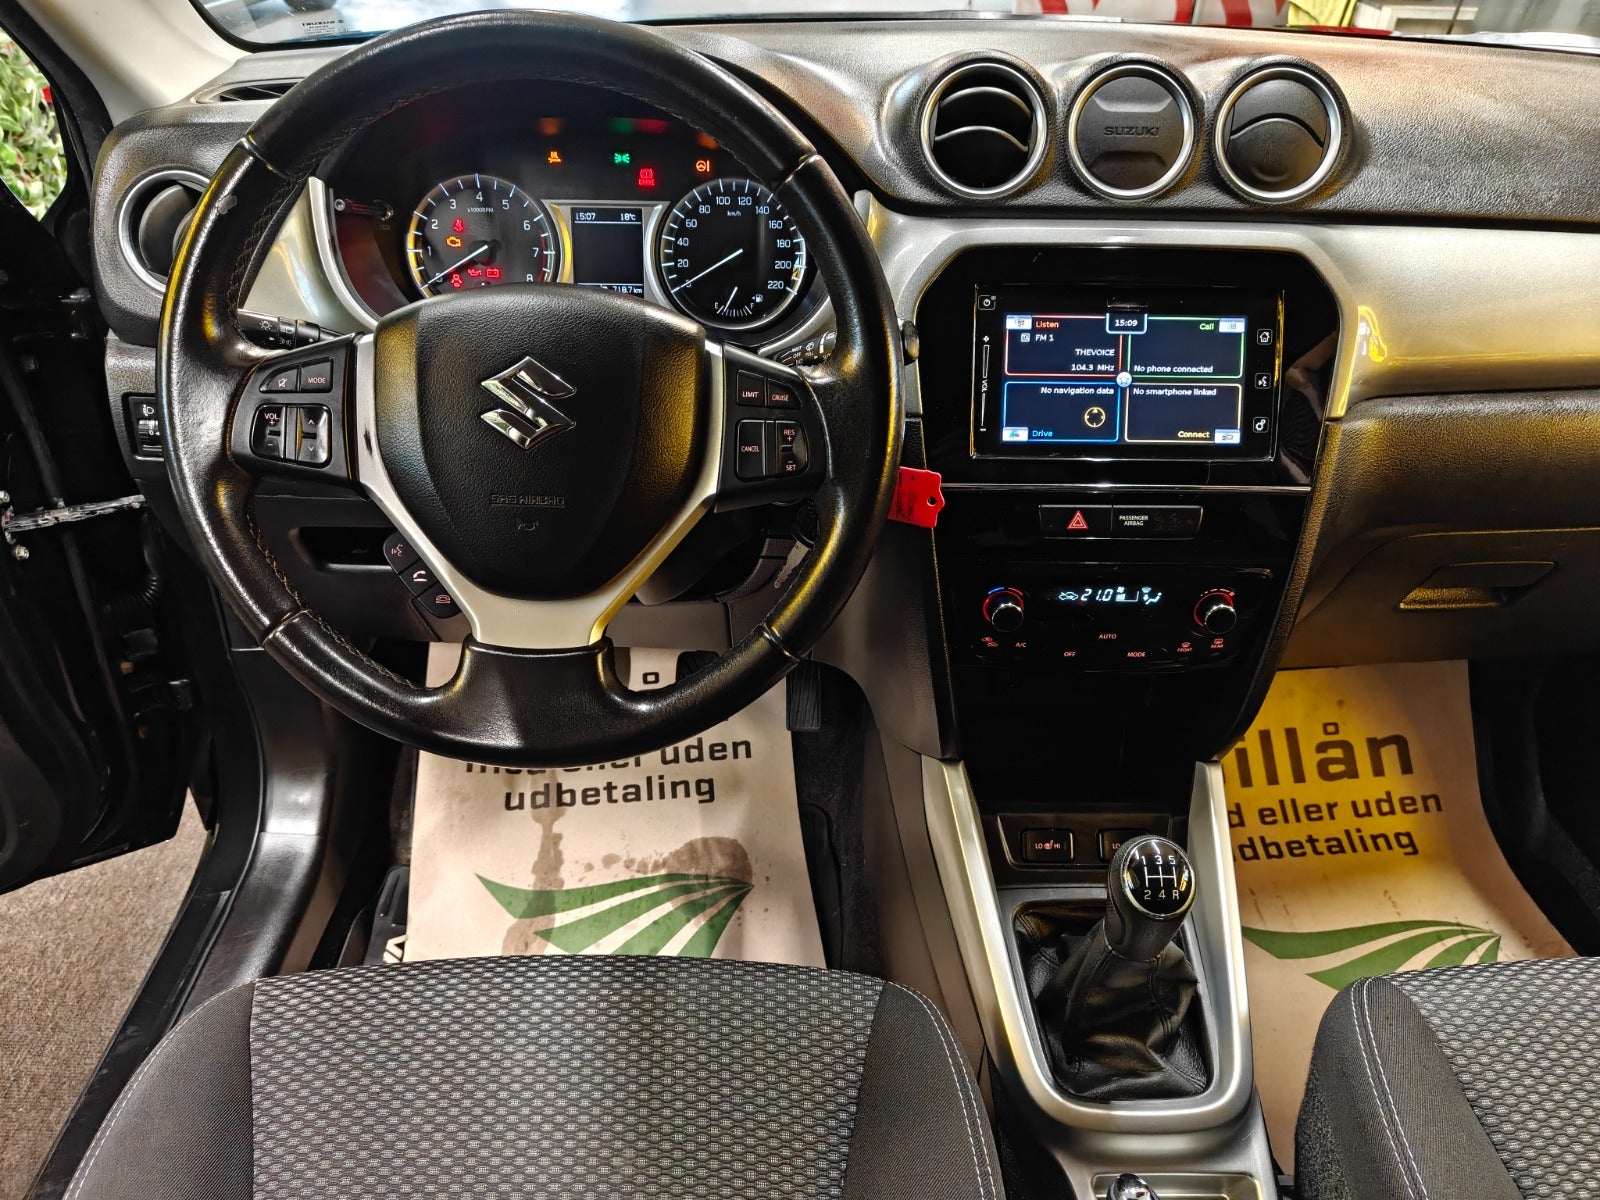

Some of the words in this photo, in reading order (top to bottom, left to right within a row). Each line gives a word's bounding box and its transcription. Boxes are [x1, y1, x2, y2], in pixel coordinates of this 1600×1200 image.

[1104, 126, 1160, 137] SUZUKI
[476, 191, 484, 202] 4
[716, 196, 731, 206] 100
[738, 196, 753, 206] 120
[450, 199, 457, 210] 3
[502, 200, 511, 210] 5
[698, 204, 711, 214] 80
[755, 205, 770, 215] 140
[575, 212, 596, 221] 15:07
[431, 219, 439, 230] 2
[523, 220, 531, 231] 6
[685, 219, 698, 228] 60
[768, 220, 783, 230] 160
[677, 238, 689, 247] 40
[776, 239, 791, 249] 180
[427, 246, 432, 256] 1
[533, 248, 539, 258] 7
[677, 259, 689, 268] 20
[774, 260, 792, 270] 200
[767, 280, 784, 290] 220
[1035, 320, 1060, 329] Listen
[1114, 319, 1138, 327] 15:09
[1199, 322, 1215, 331] Call
[1035, 333, 1047, 342] FM
[1075, 347, 1115, 356] THEVOICE
[1071, 363, 1094, 371] 104.3
[1097, 363, 1115, 371] MHz
[1133, 364, 1146, 373] No
[1147, 365, 1171, 375] phone
[1172, 365, 1214, 374] connected
[308, 376, 326, 384] MODE
[1040, 385, 1052, 394] No
[1053, 385, 1095, 396] navigation
[1096, 386, 1115, 395] data
[1133, 387, 1145, 396] No
[1145, 387, 1192, 397] smartphone
[1193, 387, 1217, 396] linked
[264, 412, 279, 420] VOL
[1032, 429, 1054, 438] Drive
[1177, 430, 1210, 439] Connect
[741, 445, 759, 453] CANCEL
[785, 464, 797, 472] SET
[1080, 588, 1114, 602] 21.0
[1127, 651, 1147, 659] MODE
[660, 737, 752, 766] uden
[1221, 721, 1415, 790] illån
[504, 774, 716, 812] udbetaling
[1258, 798, 1339, 827] eller
[1351, 791, 1443, 819] uden
[1232, 827, 1420, 863] dbetaling
[1141, 855, 1147, 866] 1
[1155, 855, 1163, 865] 3
[1168, 855, 1176, 865] 5
[1144, 889, 1152, 900] 2
[1158, 889, 1166, 900] 4
[1172, 889, 1180, 900] R
